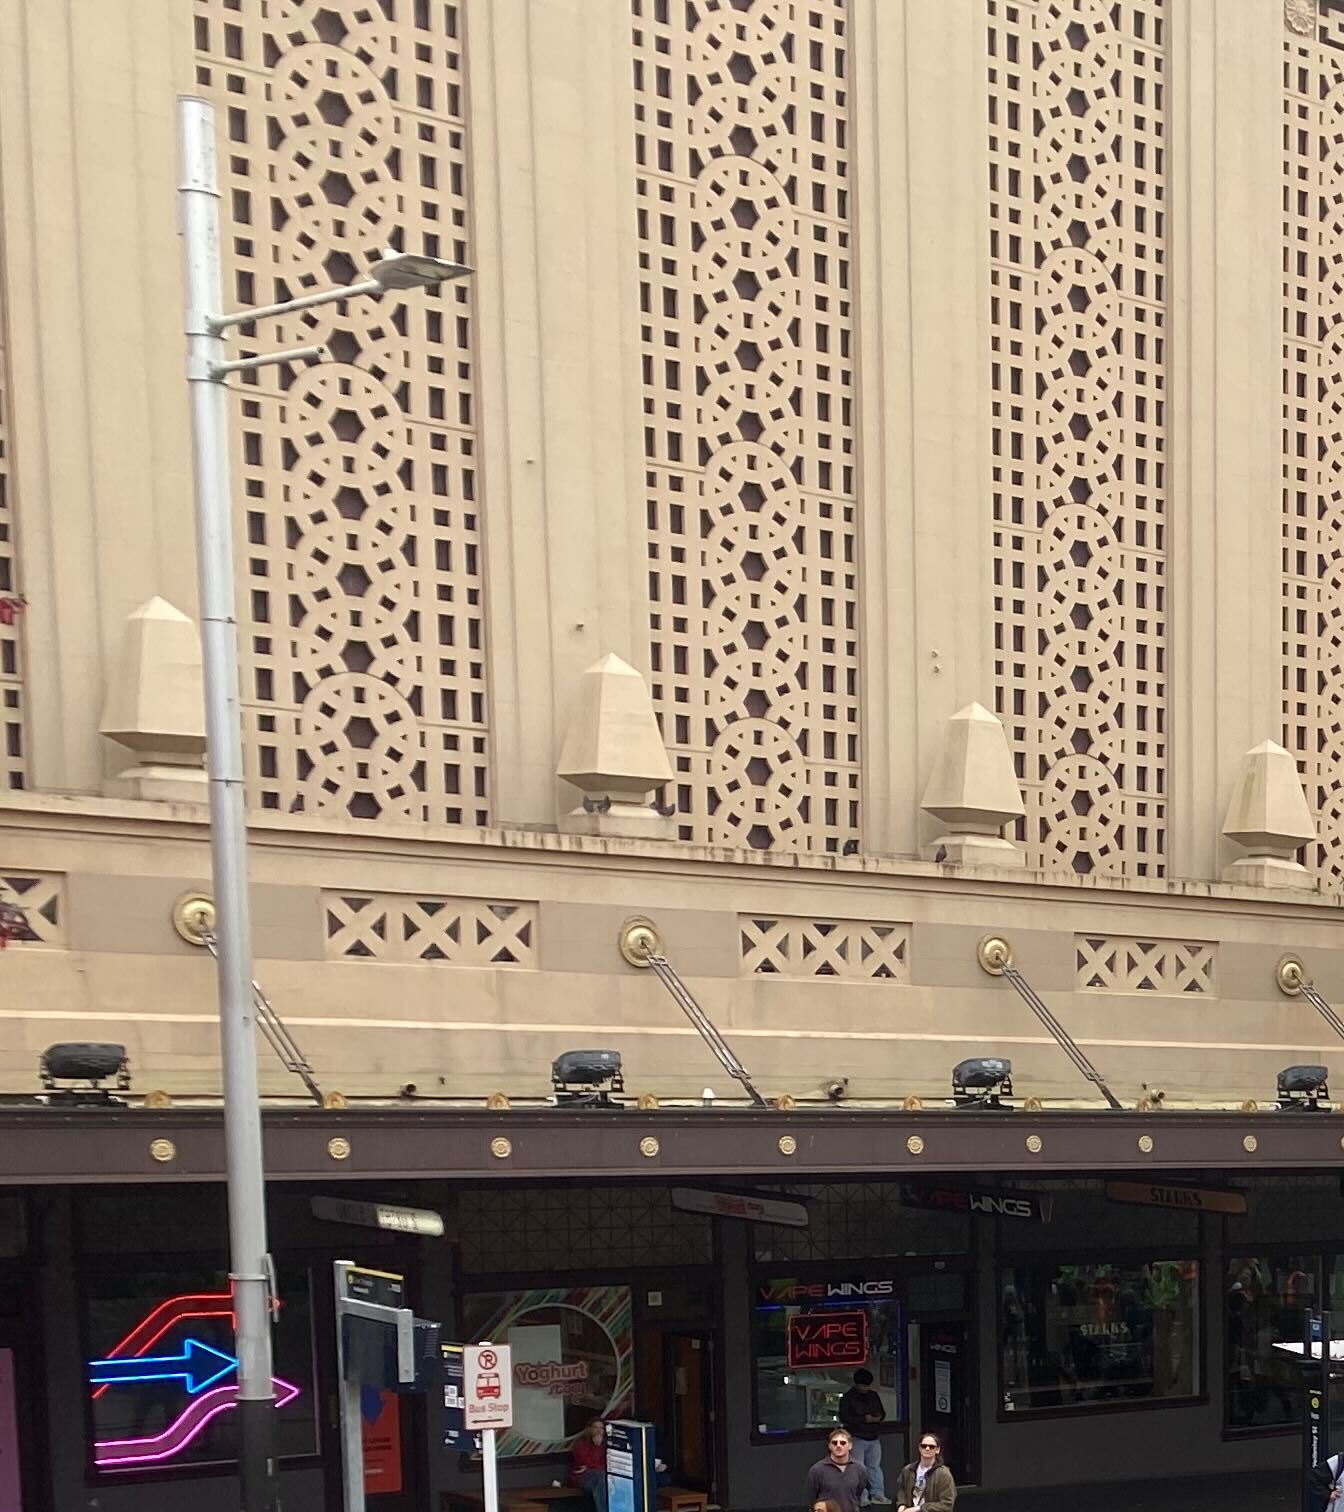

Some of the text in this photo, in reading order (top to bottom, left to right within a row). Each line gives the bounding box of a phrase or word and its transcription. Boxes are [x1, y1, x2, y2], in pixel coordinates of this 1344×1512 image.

[970, 1194, 1032, 1217] WINGS
[760, 1280, 894, 1300] VAPE WINGS
[795, 1322, 857, 1340] VAPE
[795, 1341, 861, 1359] WINGS
[516, 1361, 588, 1387] Yoghurt
[469, 1403, 509, 1414] Bus Stop
